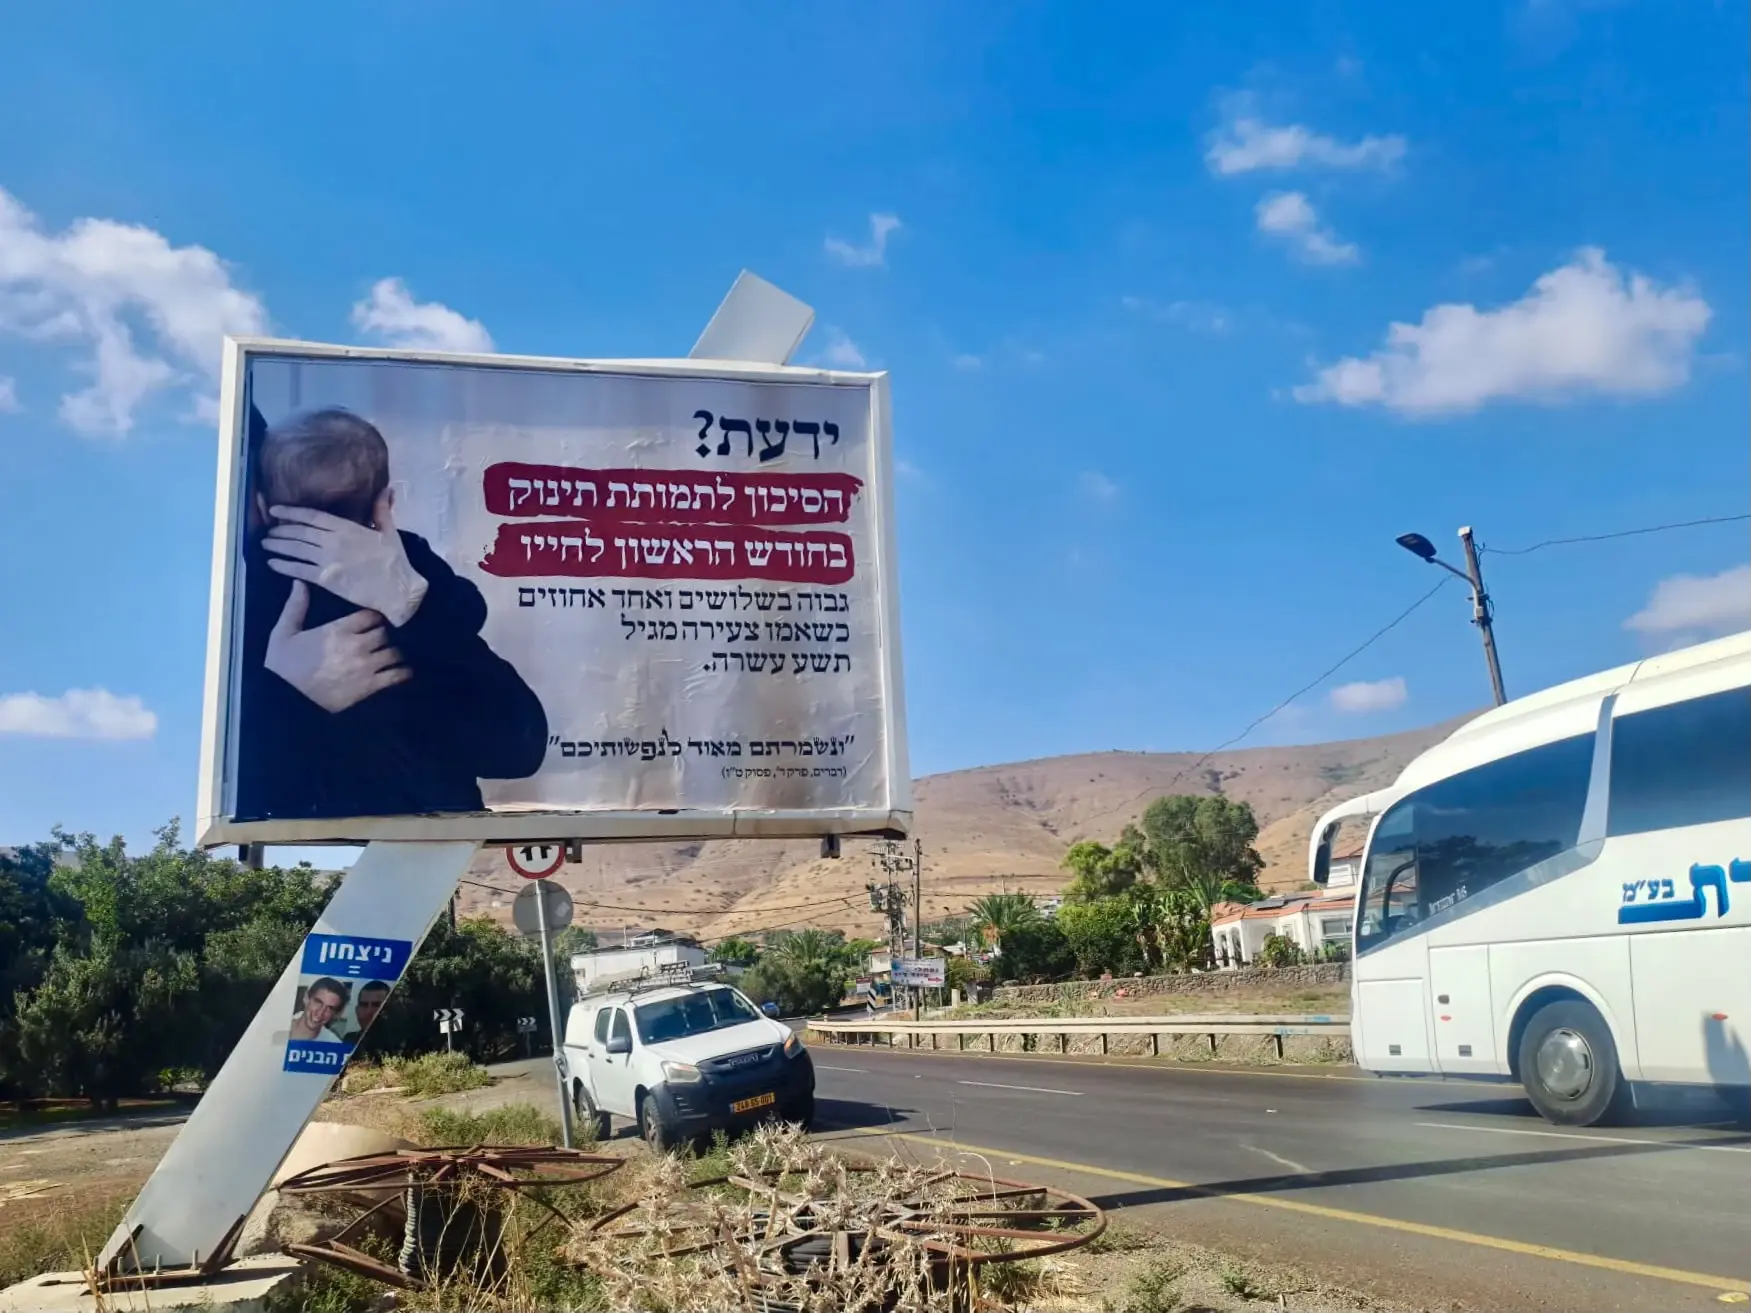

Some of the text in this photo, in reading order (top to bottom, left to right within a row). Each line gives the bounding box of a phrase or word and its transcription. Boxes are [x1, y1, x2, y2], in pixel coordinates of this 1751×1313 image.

[692, 409, 840, 462] ידעת?
[508, 476, 844, 518] הסיכון לתמותת תינוק
[520, 527, 848, 570] בחודש הראשון לחייו
[518, 585, 850, 613] גבוה בשלושים ואחד אחוזים
[621, 613, 850, 643] כשאמו צעירה מגיל
[703, 651, 852, 675] תשע עשרה.
[688, 737, 741, 757] מאוד
[319, 941, 392, 964] ניצחון
[288, 1049, 337, 1065] הבנים
